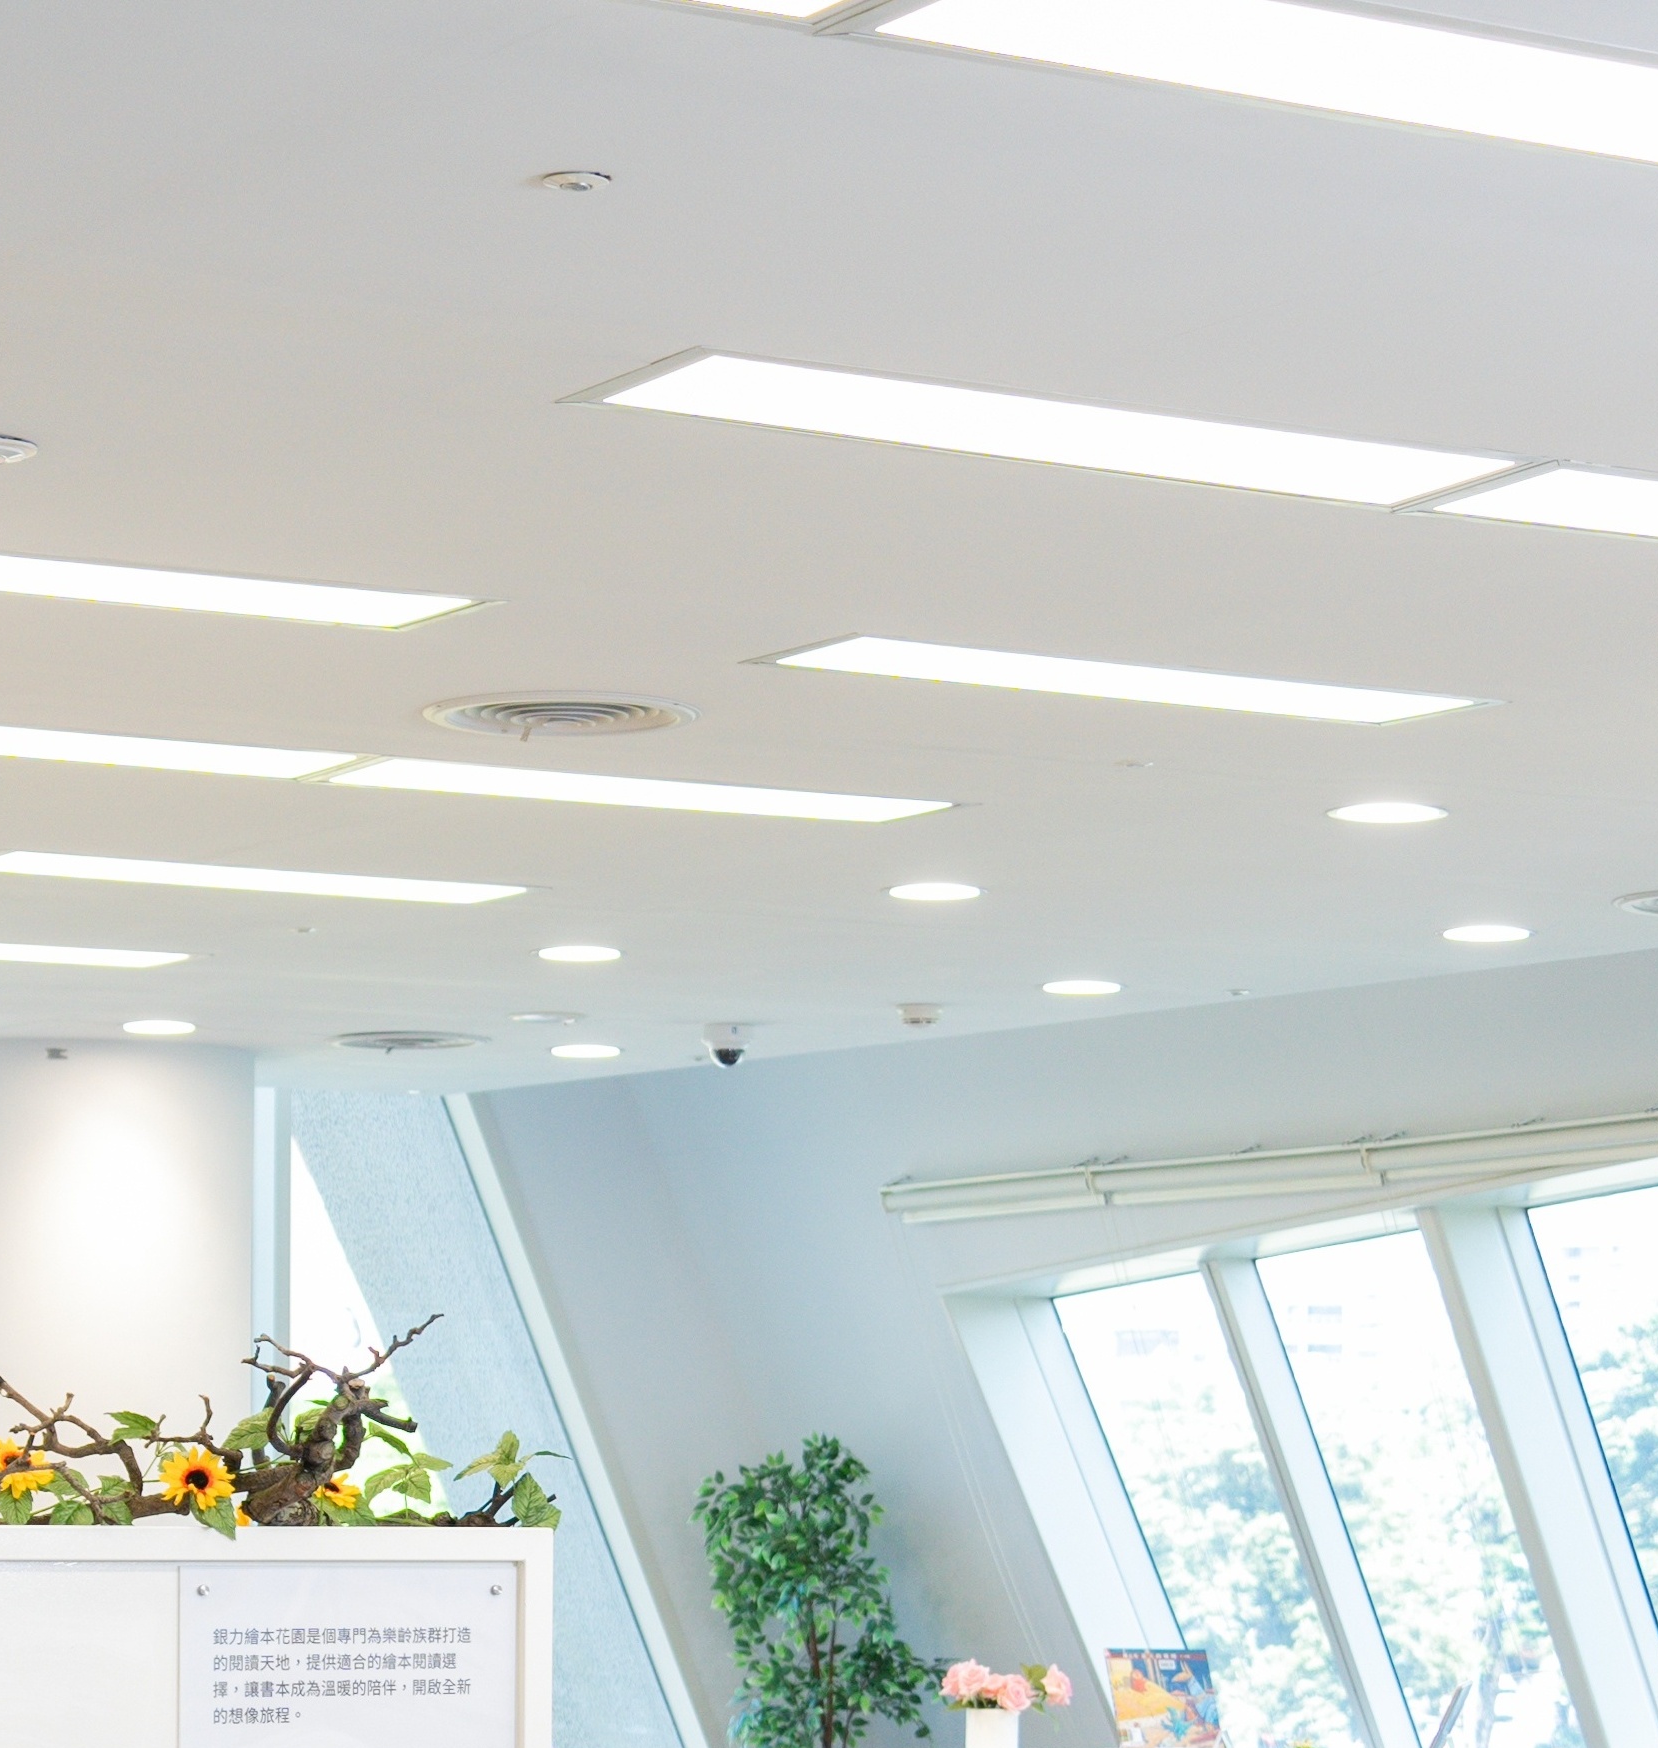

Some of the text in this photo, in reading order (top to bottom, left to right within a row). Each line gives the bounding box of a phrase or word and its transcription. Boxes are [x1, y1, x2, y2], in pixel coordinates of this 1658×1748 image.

[213, 1627, 471, 1645] 銀力繪本花園是個專門為樂齡族群打造
[213, 1654, 457, 1671] 的閱讀天地，提供適合的繪本閱讀選
[213, 1679, 471, 1697] 擇，讓書本成為溫暖的陪伴，開啟全新
[213, 1707, 304, 1724] 的想像旅程。
